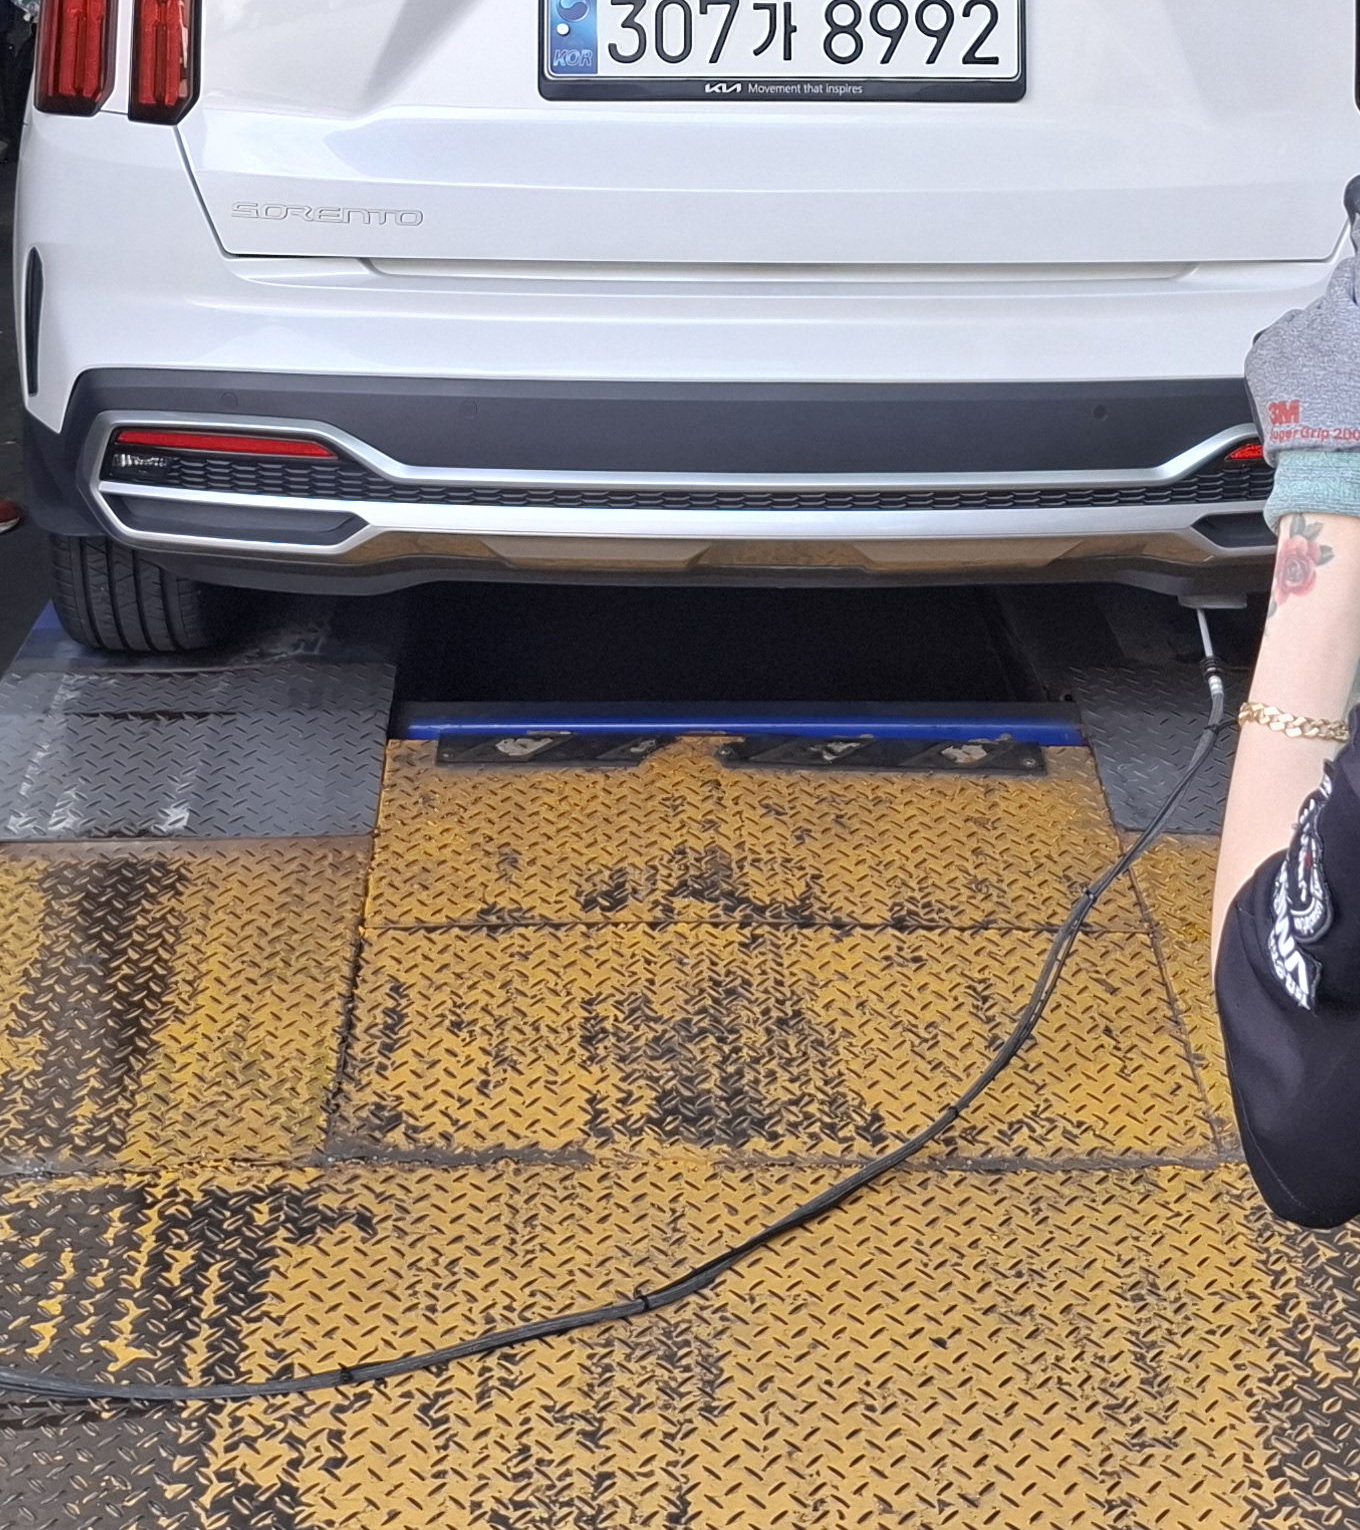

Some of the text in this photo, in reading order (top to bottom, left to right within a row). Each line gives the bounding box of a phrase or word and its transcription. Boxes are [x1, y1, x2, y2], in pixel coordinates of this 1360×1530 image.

[553, 49, 593, 66] KOR
[748, 83, 801, 94] Movement
[804, 83, 823, 94] that
[826, 83, 863, 96] inspires
[231, 202, 423, 226] SORENTO
[1268, 400, 1301, 425] 3M
